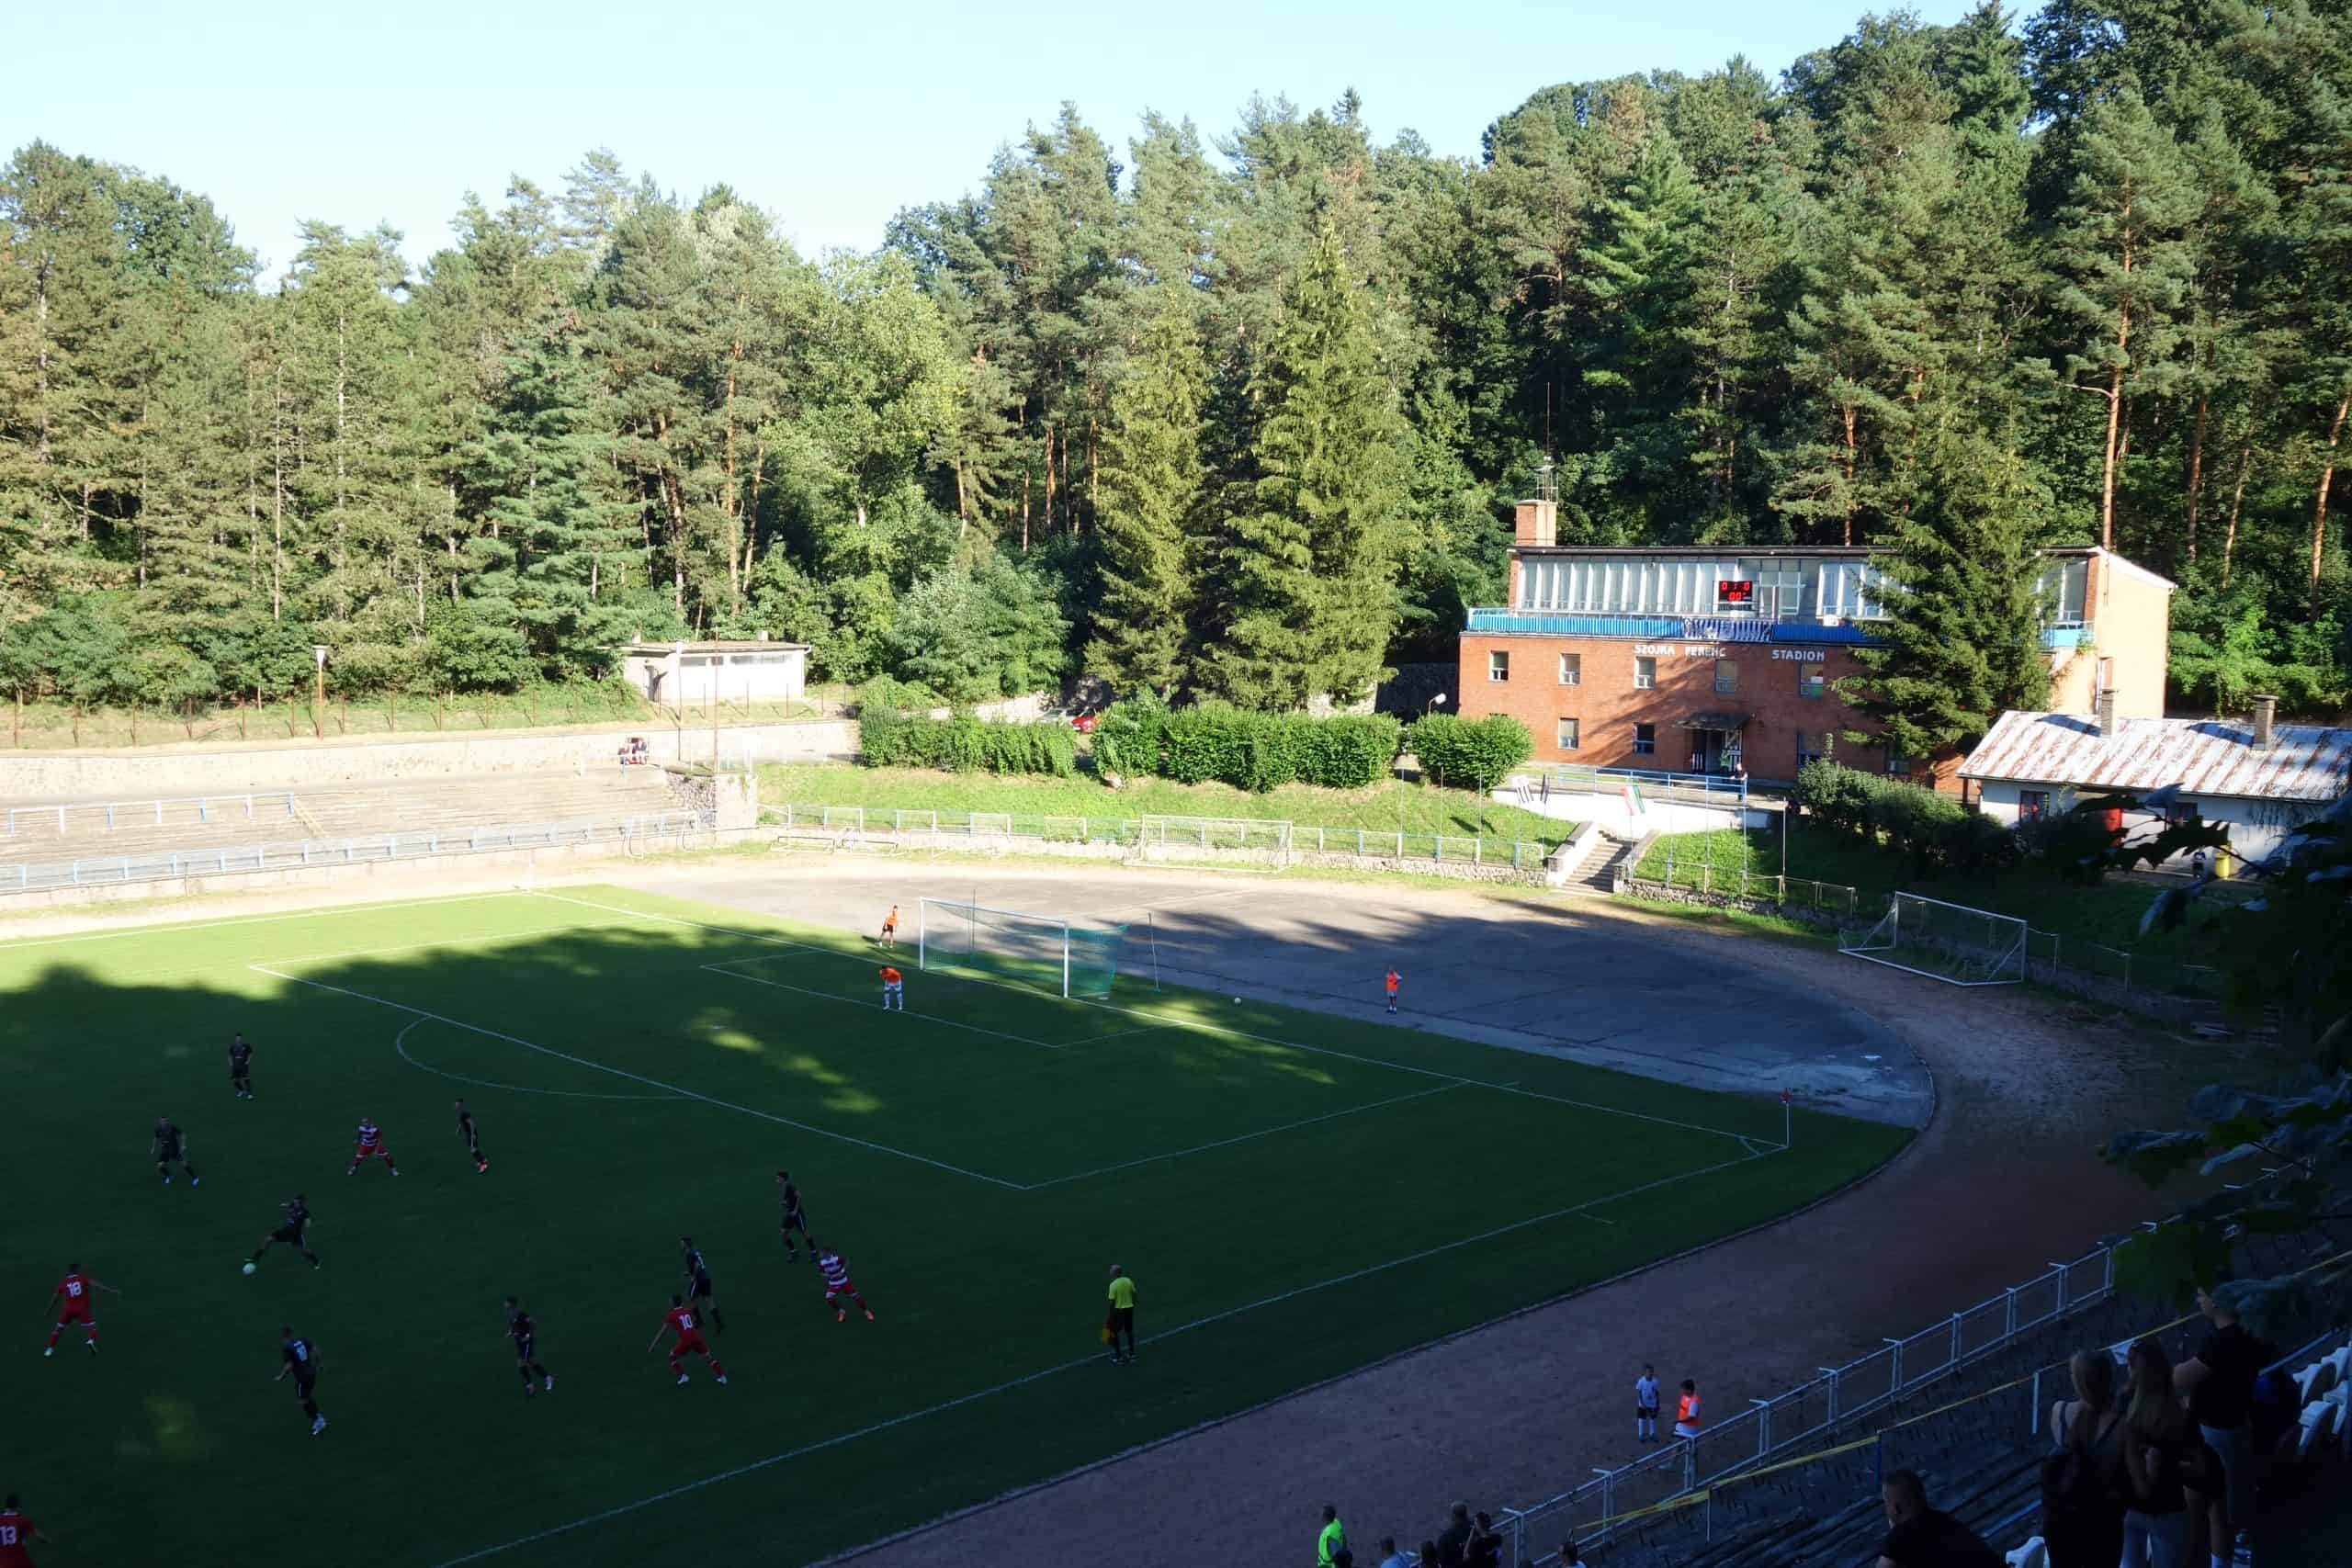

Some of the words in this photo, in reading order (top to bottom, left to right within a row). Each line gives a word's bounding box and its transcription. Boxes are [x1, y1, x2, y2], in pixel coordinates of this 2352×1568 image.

[1721, 582, 1728, 591] 0
[1743, 582, 1750, 591] 0
[1634, 645, 1675, 656] SZOJKA
[1685, 646, 1726, 657] FERENC
[1771, 649, 1825, 660] STADION
[67, 1280, 82, 1298] 18
[678, 1314, 693, 1330] 10
[0, 1525, 17, 1546] 13
